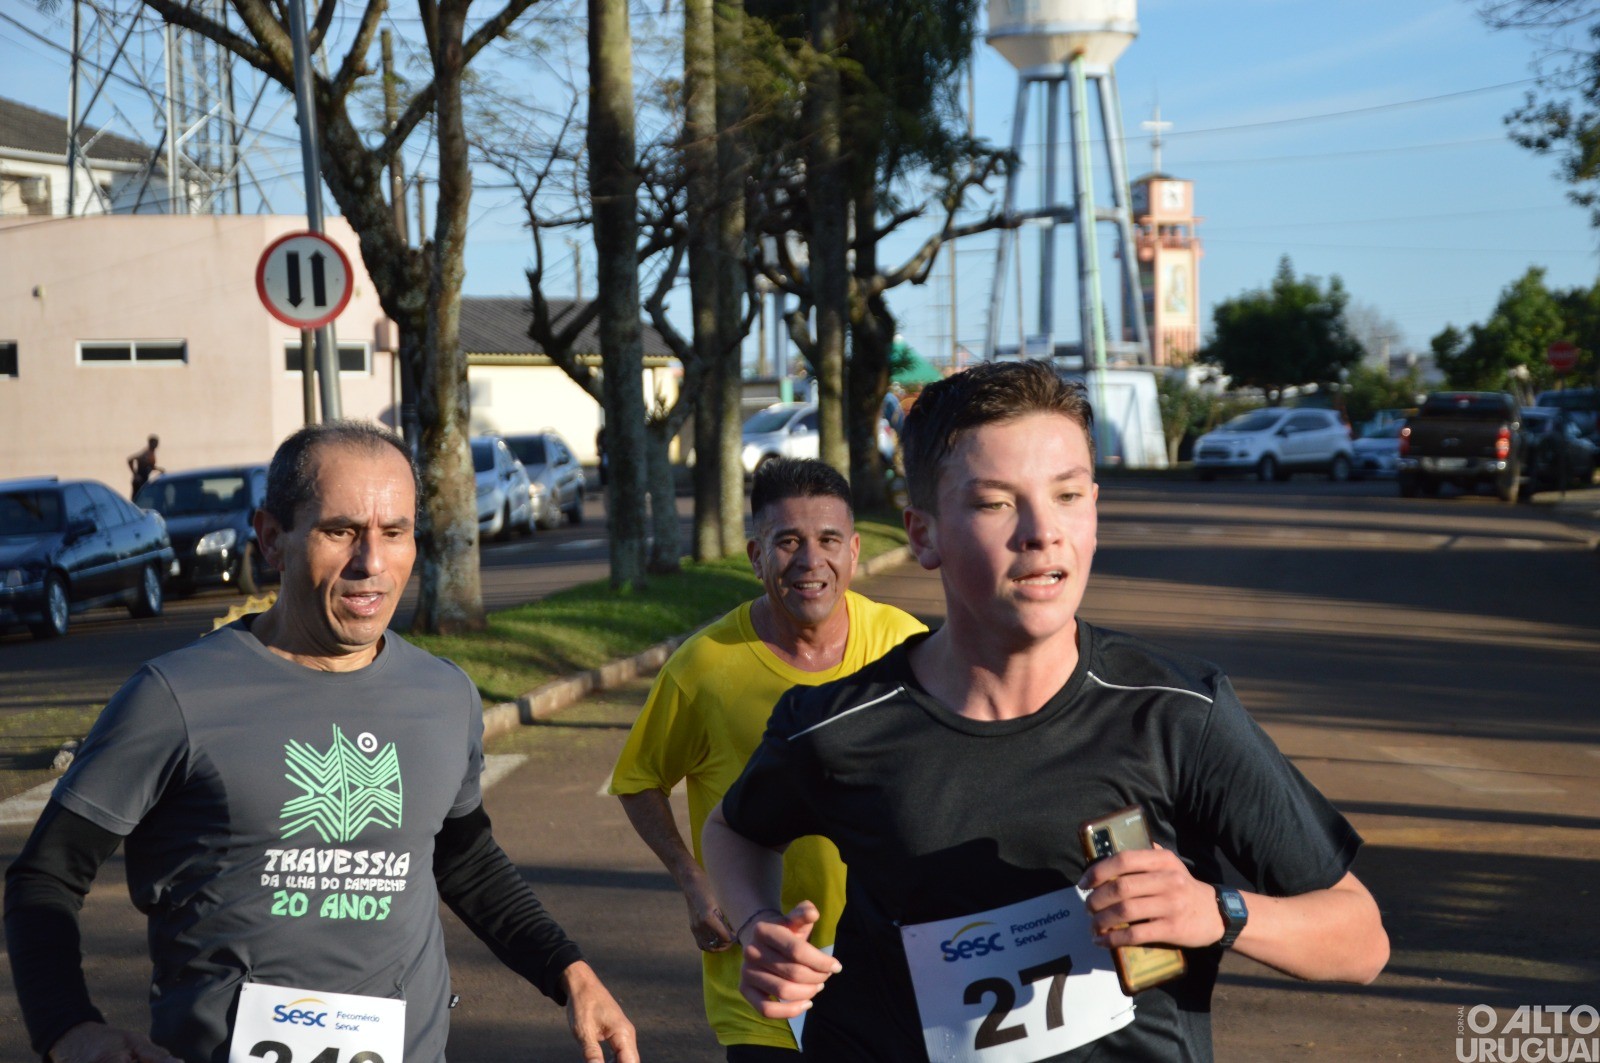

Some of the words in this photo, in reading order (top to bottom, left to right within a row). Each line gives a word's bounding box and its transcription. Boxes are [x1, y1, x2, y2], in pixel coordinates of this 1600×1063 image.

[264, 847, 411, 877] TRAVESSIA
[260, 873, 280, 888] DA
[285, 875, 316, 890] ILHA
[320, 877, 340, 891] DO
[344, 877, 407, 892] CAMPECHE
[271, 890, 309, 917] 20
[319, 893, 392, 921] ANOS
[963, 955, 1073, 1050] 27
